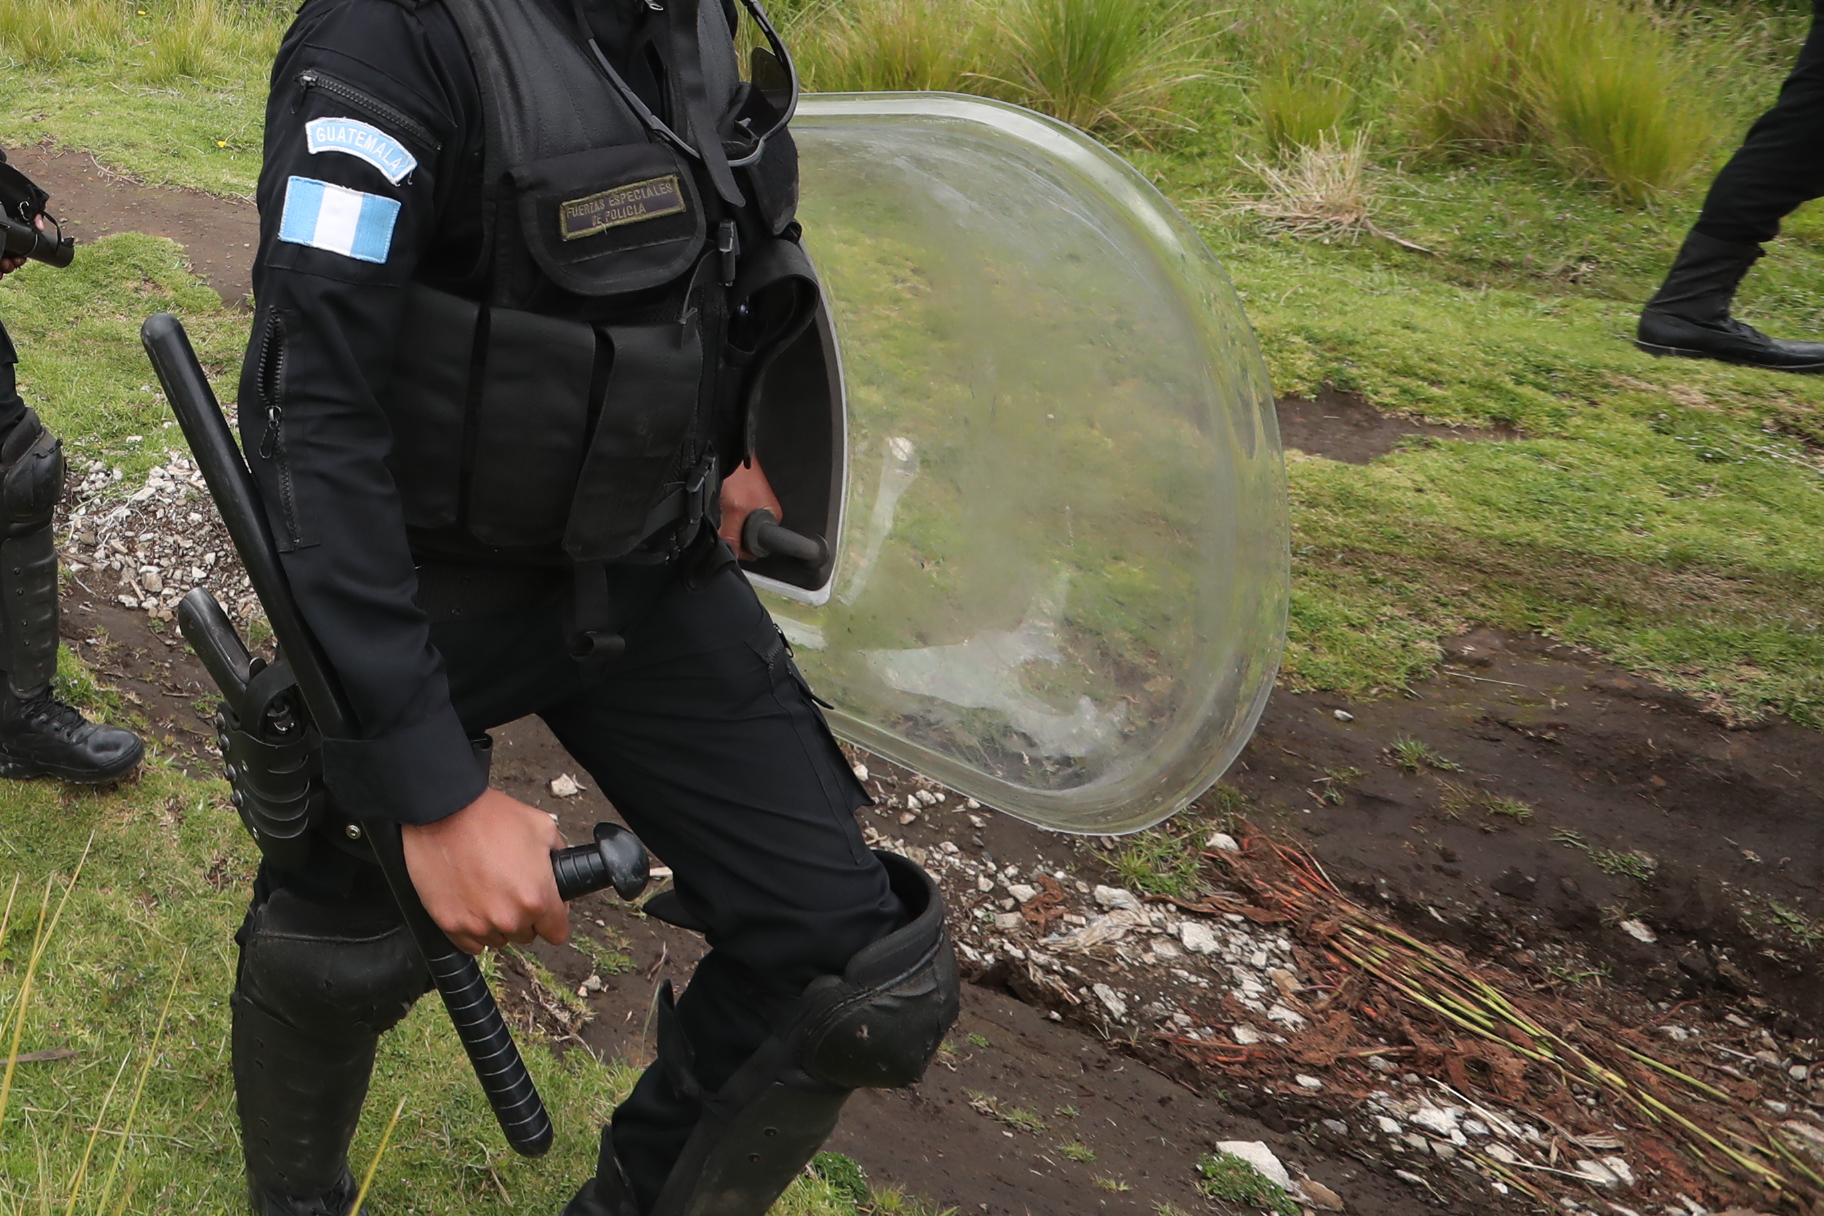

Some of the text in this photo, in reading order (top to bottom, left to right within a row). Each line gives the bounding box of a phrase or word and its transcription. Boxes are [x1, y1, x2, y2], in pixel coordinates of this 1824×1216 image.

[316, 126, 404, 172] GUATEMALA
[566, 182, 674, 219] FUERZAS ESPECIALES
[591, 203, 647, 227] DE POLICIA
